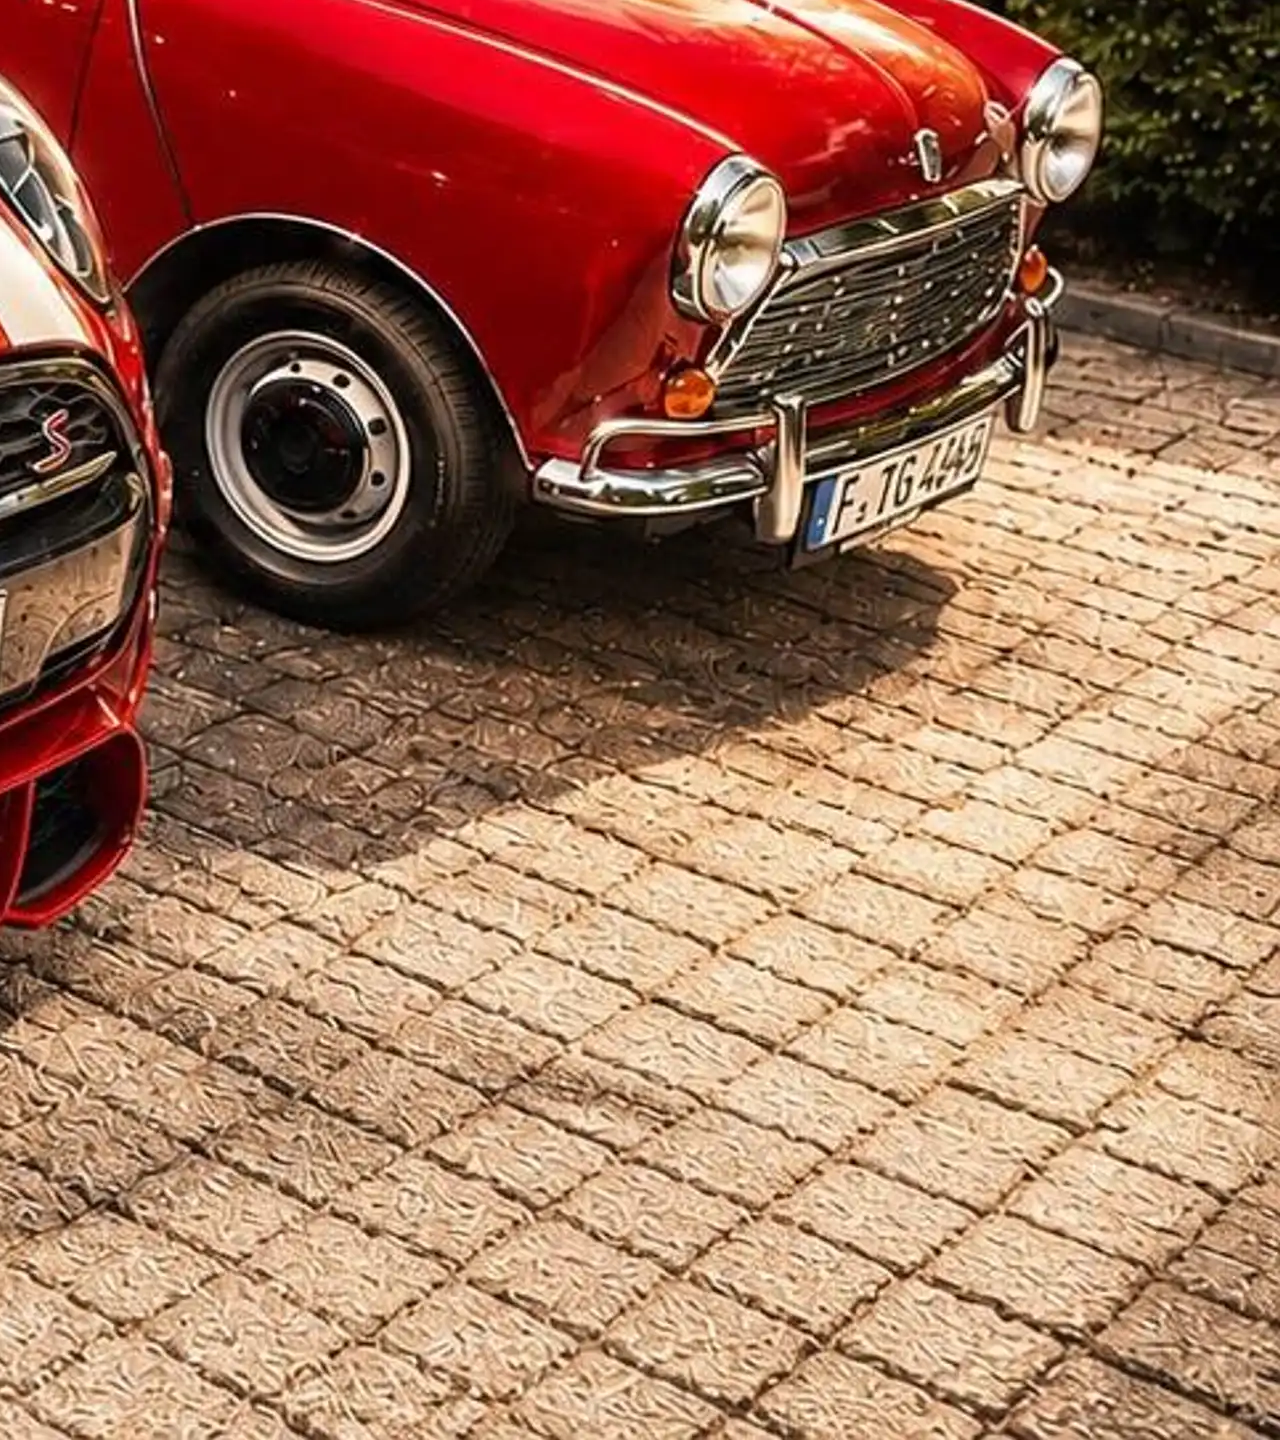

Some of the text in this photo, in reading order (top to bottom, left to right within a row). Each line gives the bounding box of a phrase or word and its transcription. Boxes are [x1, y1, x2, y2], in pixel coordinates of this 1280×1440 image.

[32, 408, 72, 474] S
[831, 473, 860, 535] F
[877, 455, 917, 515] TG
